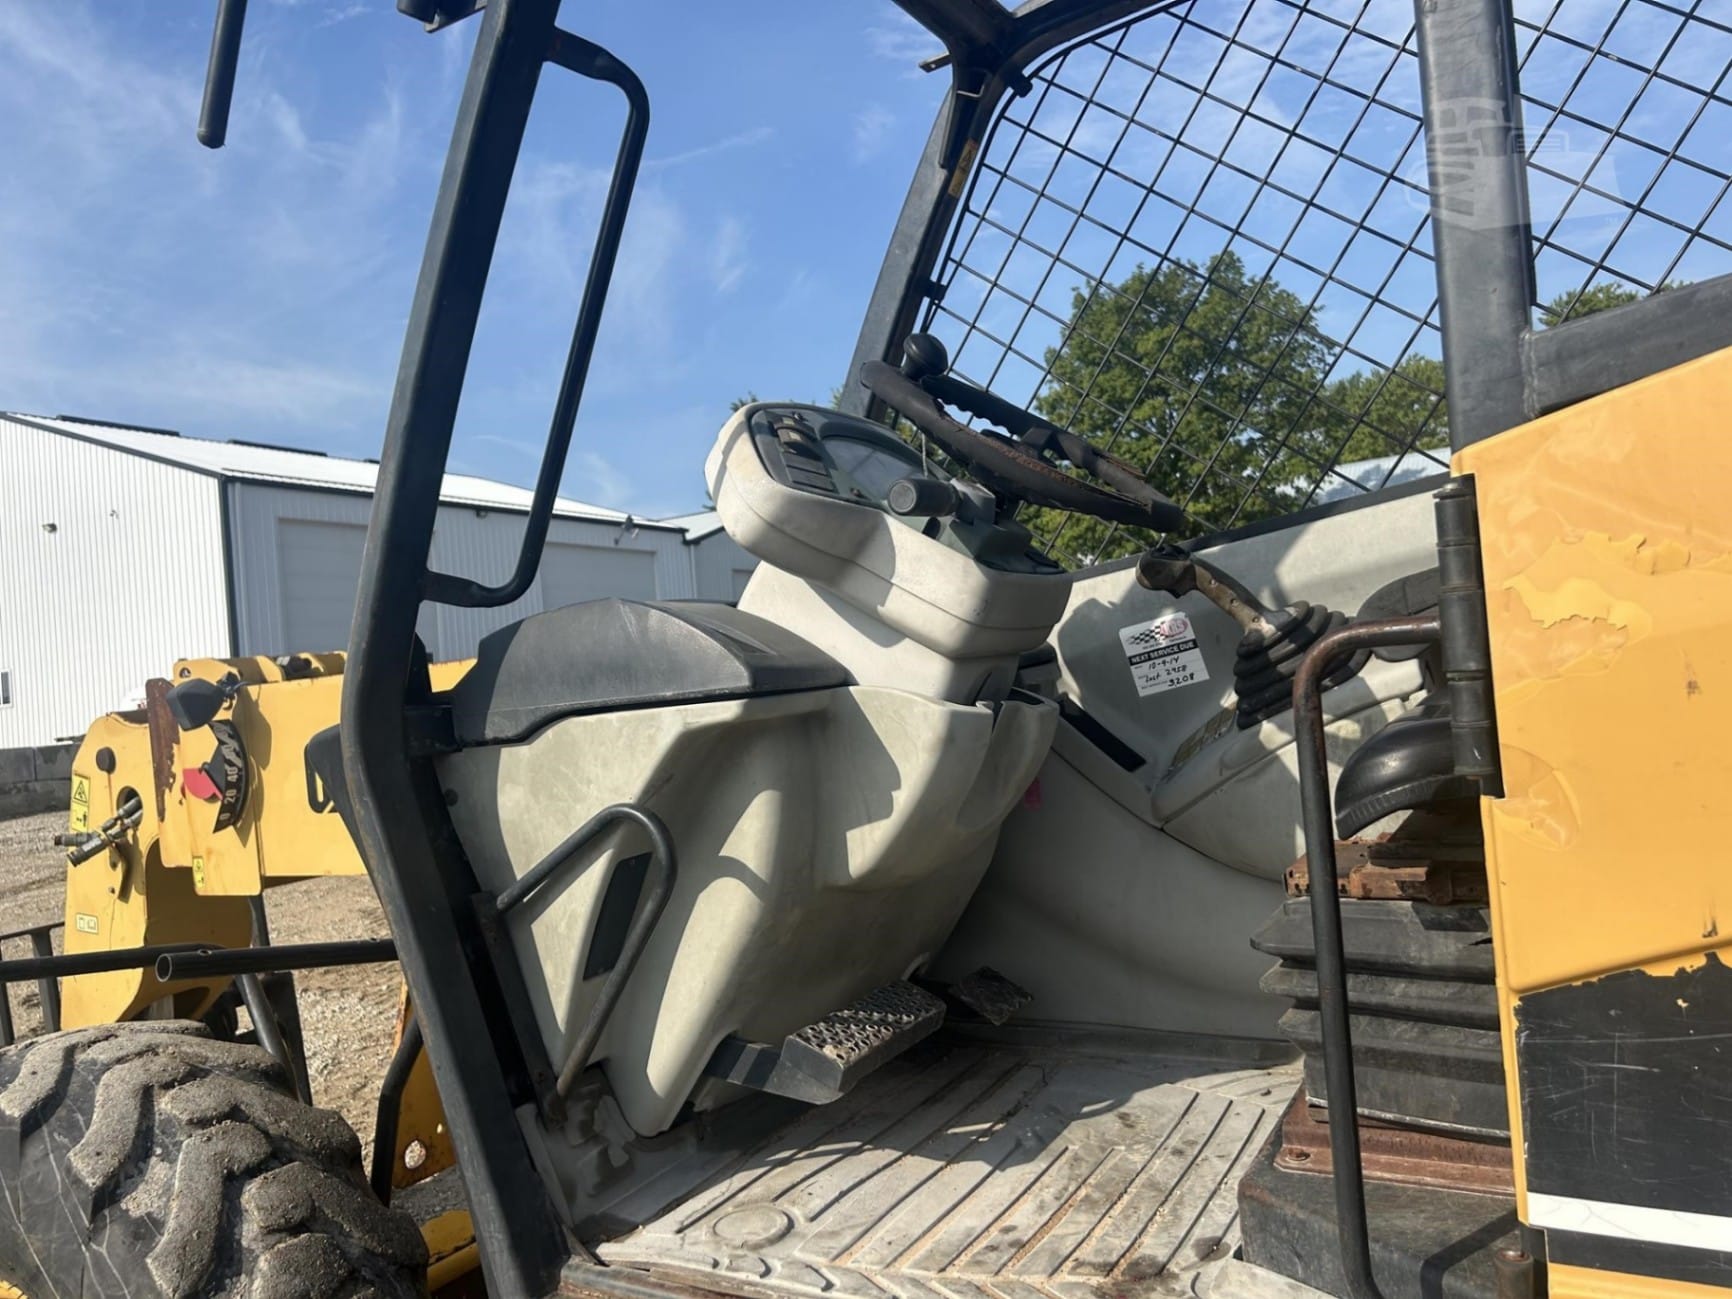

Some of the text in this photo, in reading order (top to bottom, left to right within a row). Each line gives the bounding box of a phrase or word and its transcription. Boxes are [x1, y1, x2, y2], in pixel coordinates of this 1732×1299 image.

[1131, 641, 1195, 663] NEXT SERVICE DUE
[227, 766, 238, 782] 40
[224, 789, 237, 804] 20
